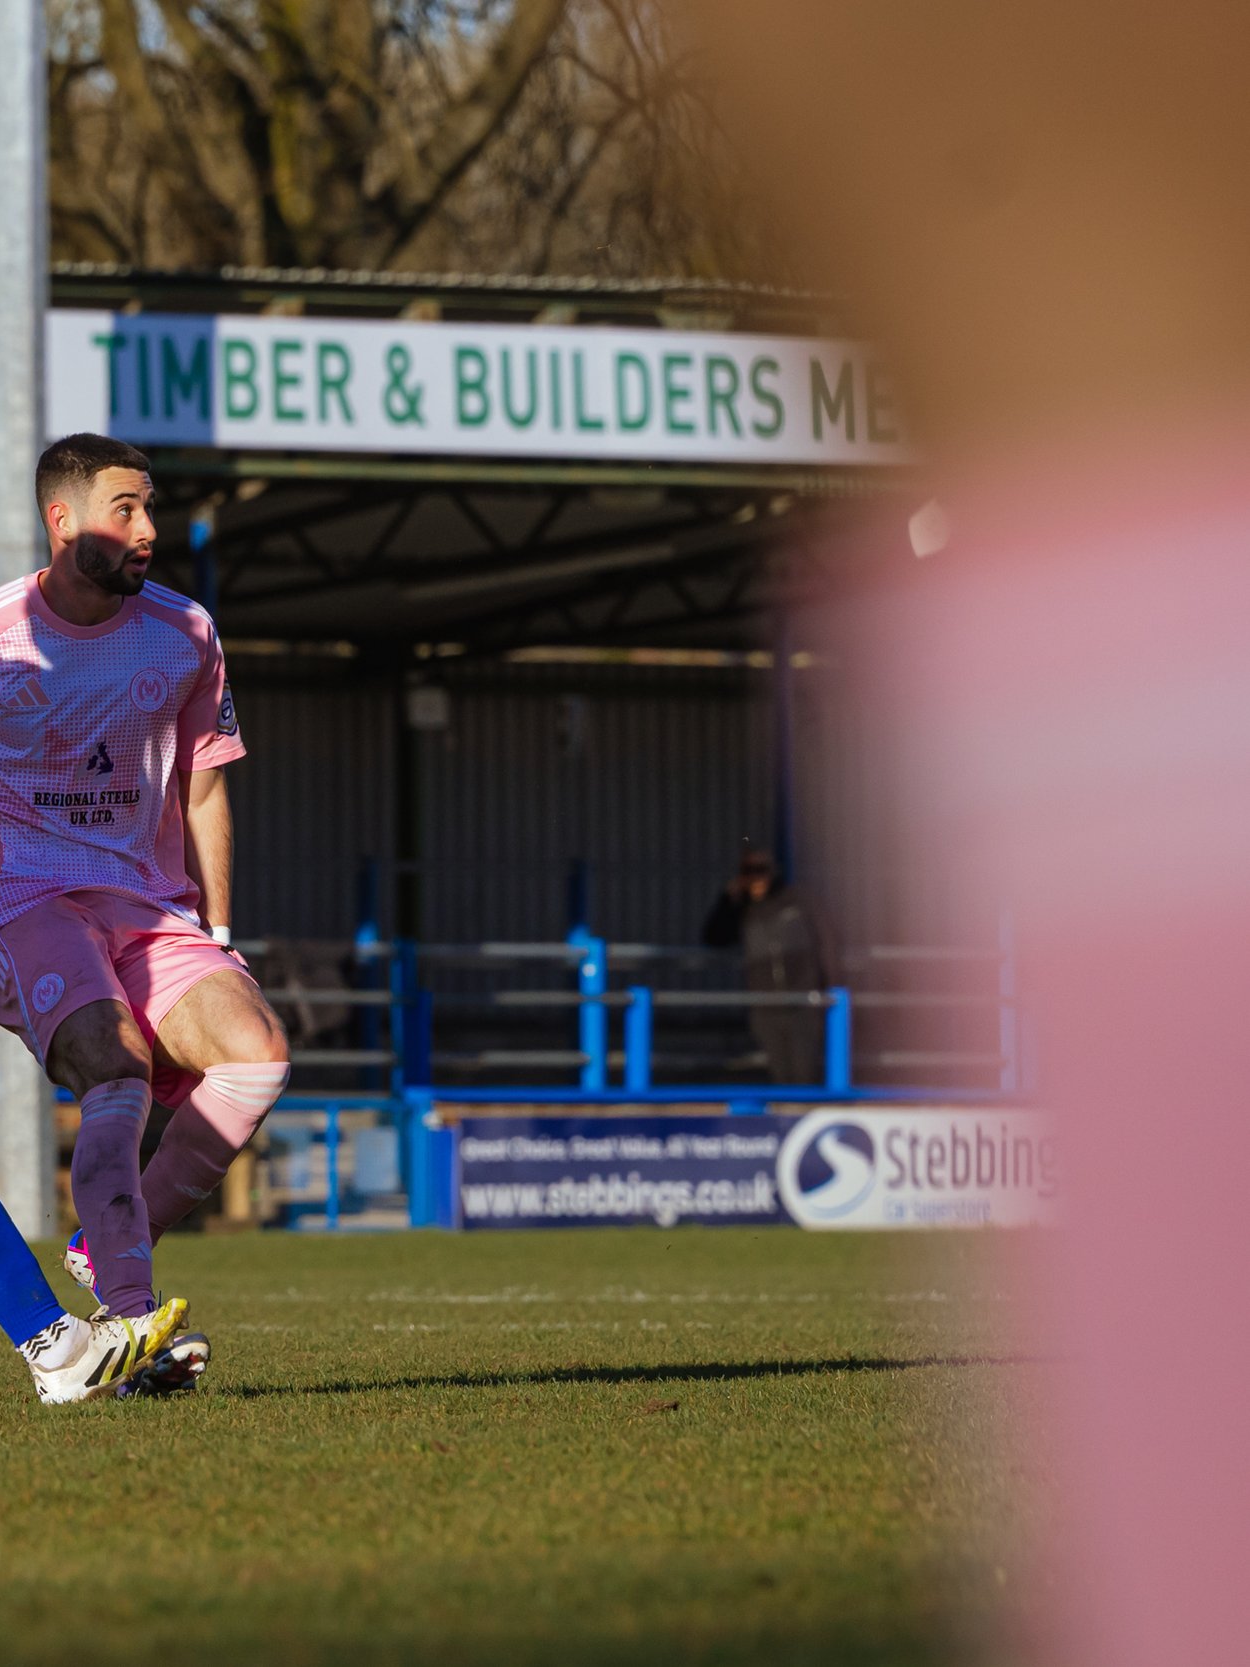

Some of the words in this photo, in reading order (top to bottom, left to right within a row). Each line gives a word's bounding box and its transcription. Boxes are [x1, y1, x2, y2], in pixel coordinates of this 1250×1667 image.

[92, 333, 356, 425] TIMBER
[385, 342, 427, 426] &
[456, 346, 784, 440] BUILDERS
[33, 791, 97, 807] REGIONAL
[99, 789, 140, 805] STEELS
[70, 811, 88, 825] UK
[461, 1170, 776, 1222] www.stebbings.co.uk
